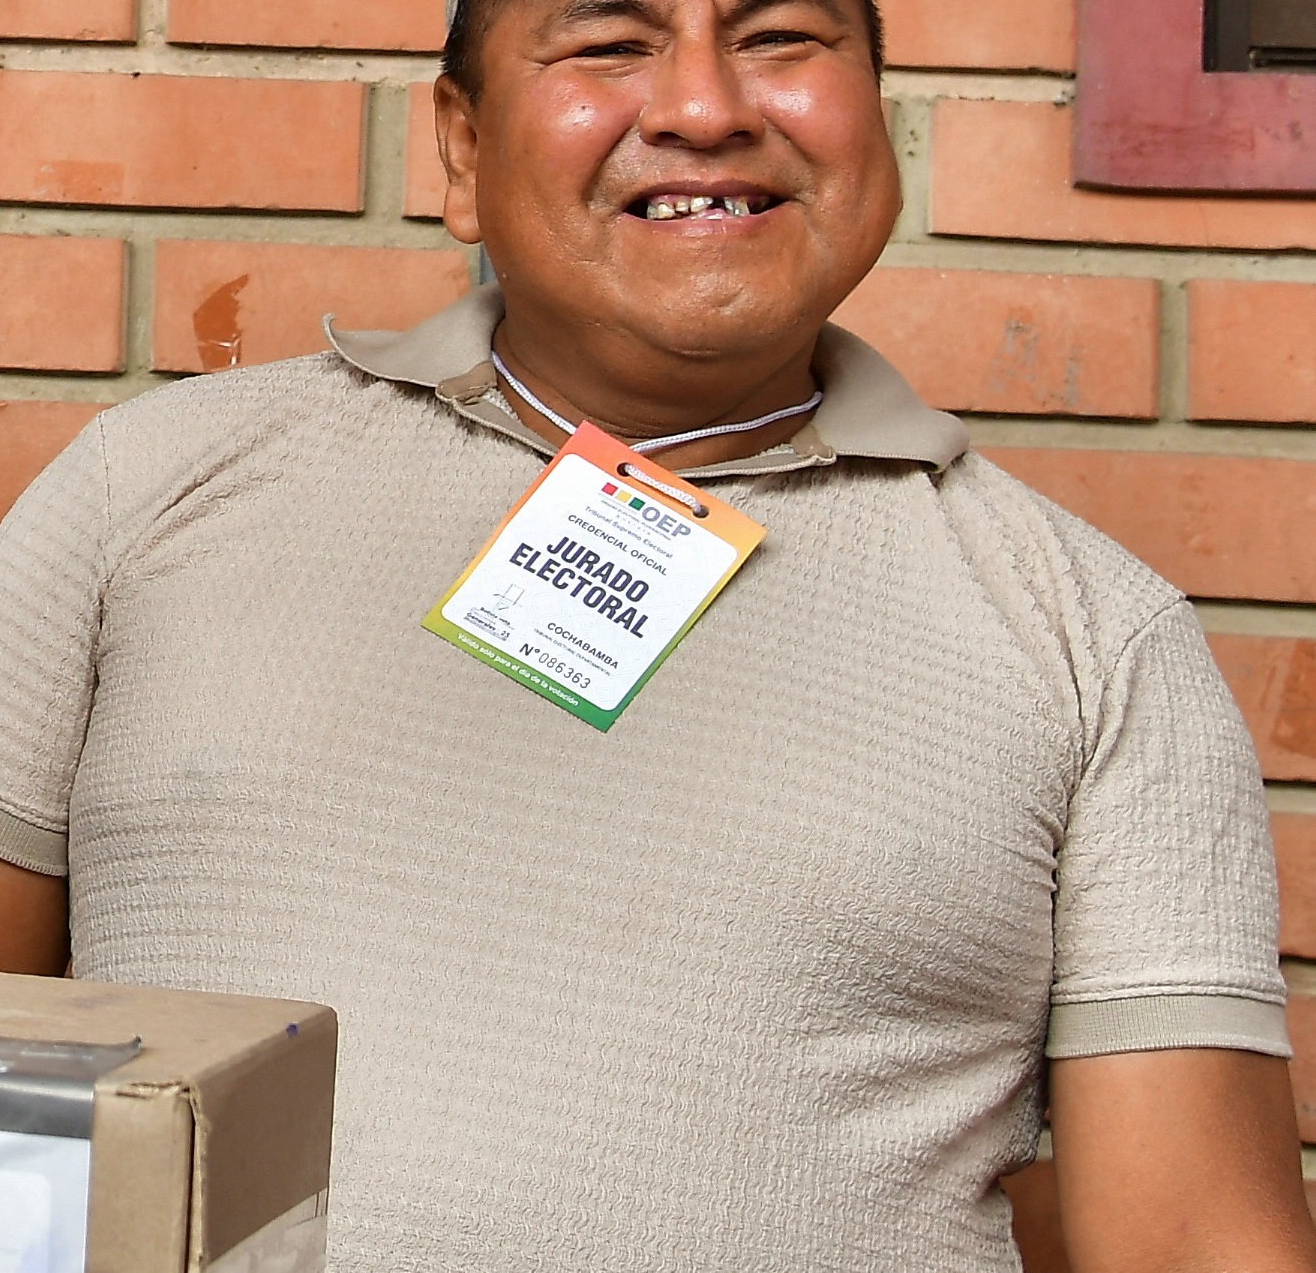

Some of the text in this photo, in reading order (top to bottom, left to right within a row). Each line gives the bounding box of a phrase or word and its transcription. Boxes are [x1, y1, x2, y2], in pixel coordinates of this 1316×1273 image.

[568, 514, 629, 553] CREDENCIAL
[630, 549, 668, 576] OFICIAL
[641, 506, 691, 537] OEP
[509, 542, 652, 638] ELECTORAL
[546, 536, 650, 603] JURADO
[494, 654, 511, 667] para
[547, 622, 619, 670] COCHABAMBA
